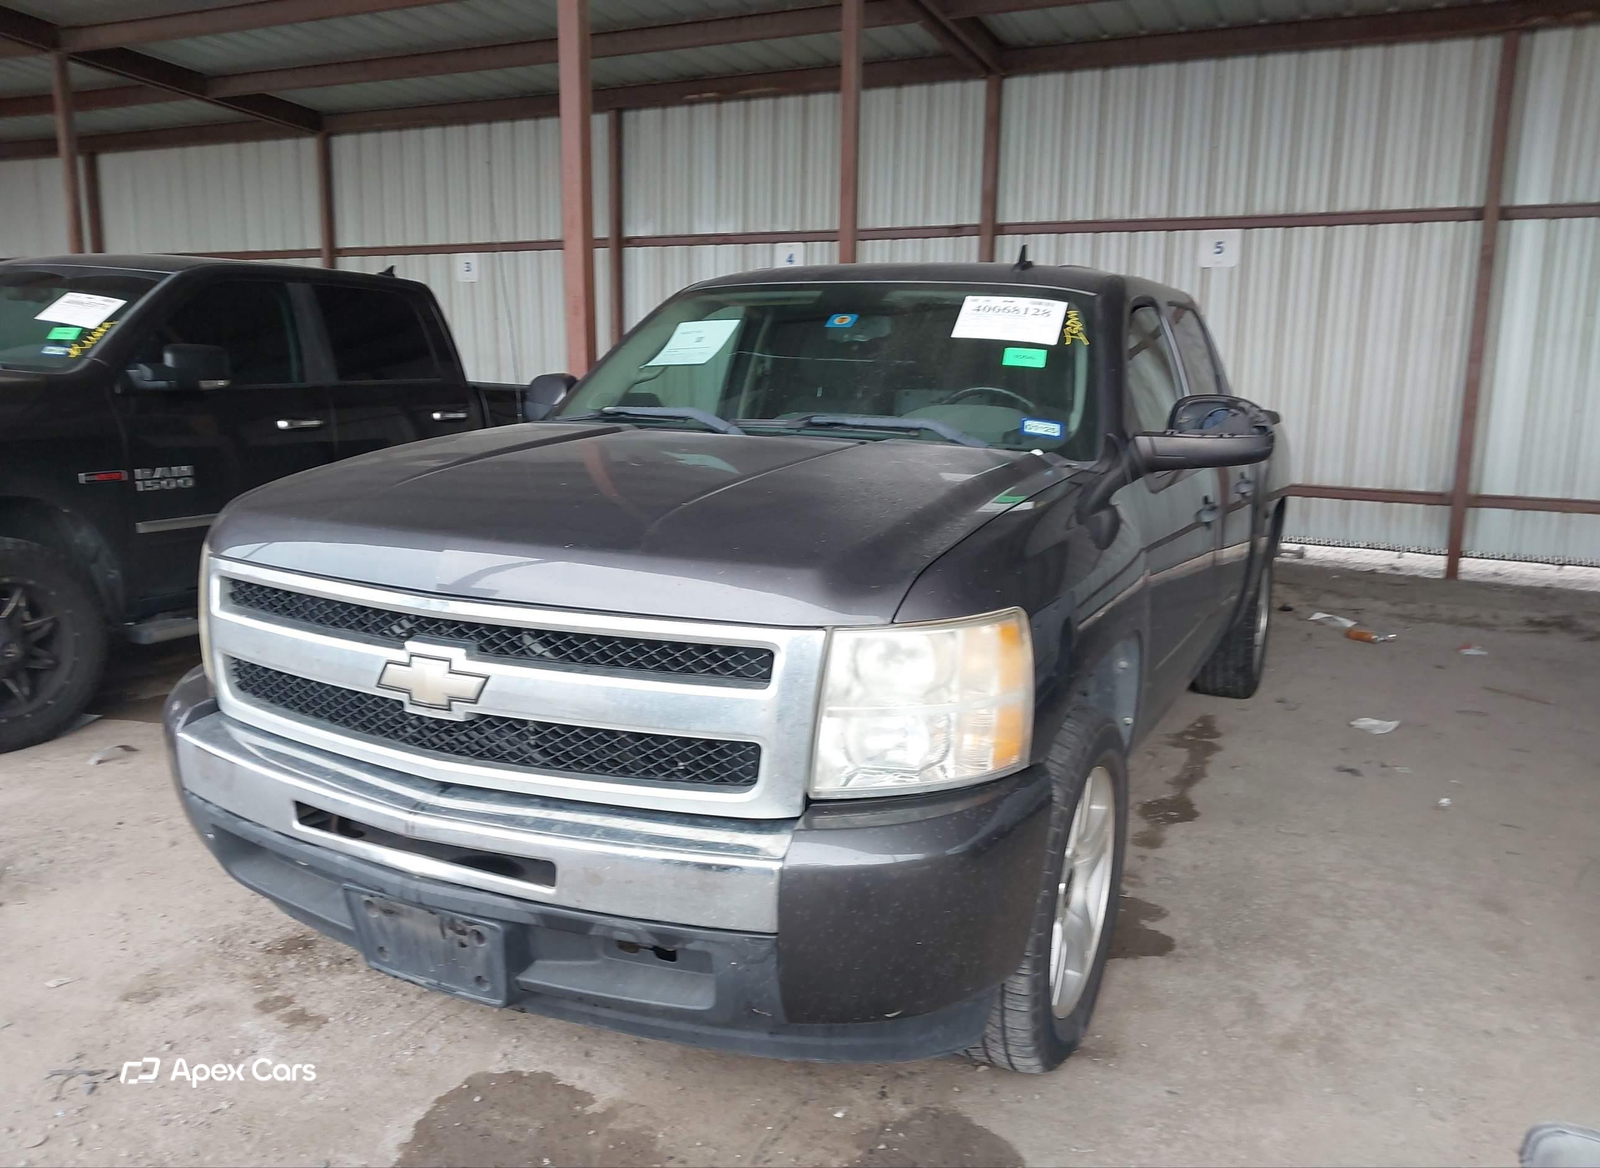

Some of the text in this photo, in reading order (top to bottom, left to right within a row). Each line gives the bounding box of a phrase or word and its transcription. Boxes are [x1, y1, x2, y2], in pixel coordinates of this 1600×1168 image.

[1213, 241, 1225, 255] 5
[785, 252, 796, 266] 4
[463, 261, 473, 273] 3
[135, 477, 195, 492] 1500
